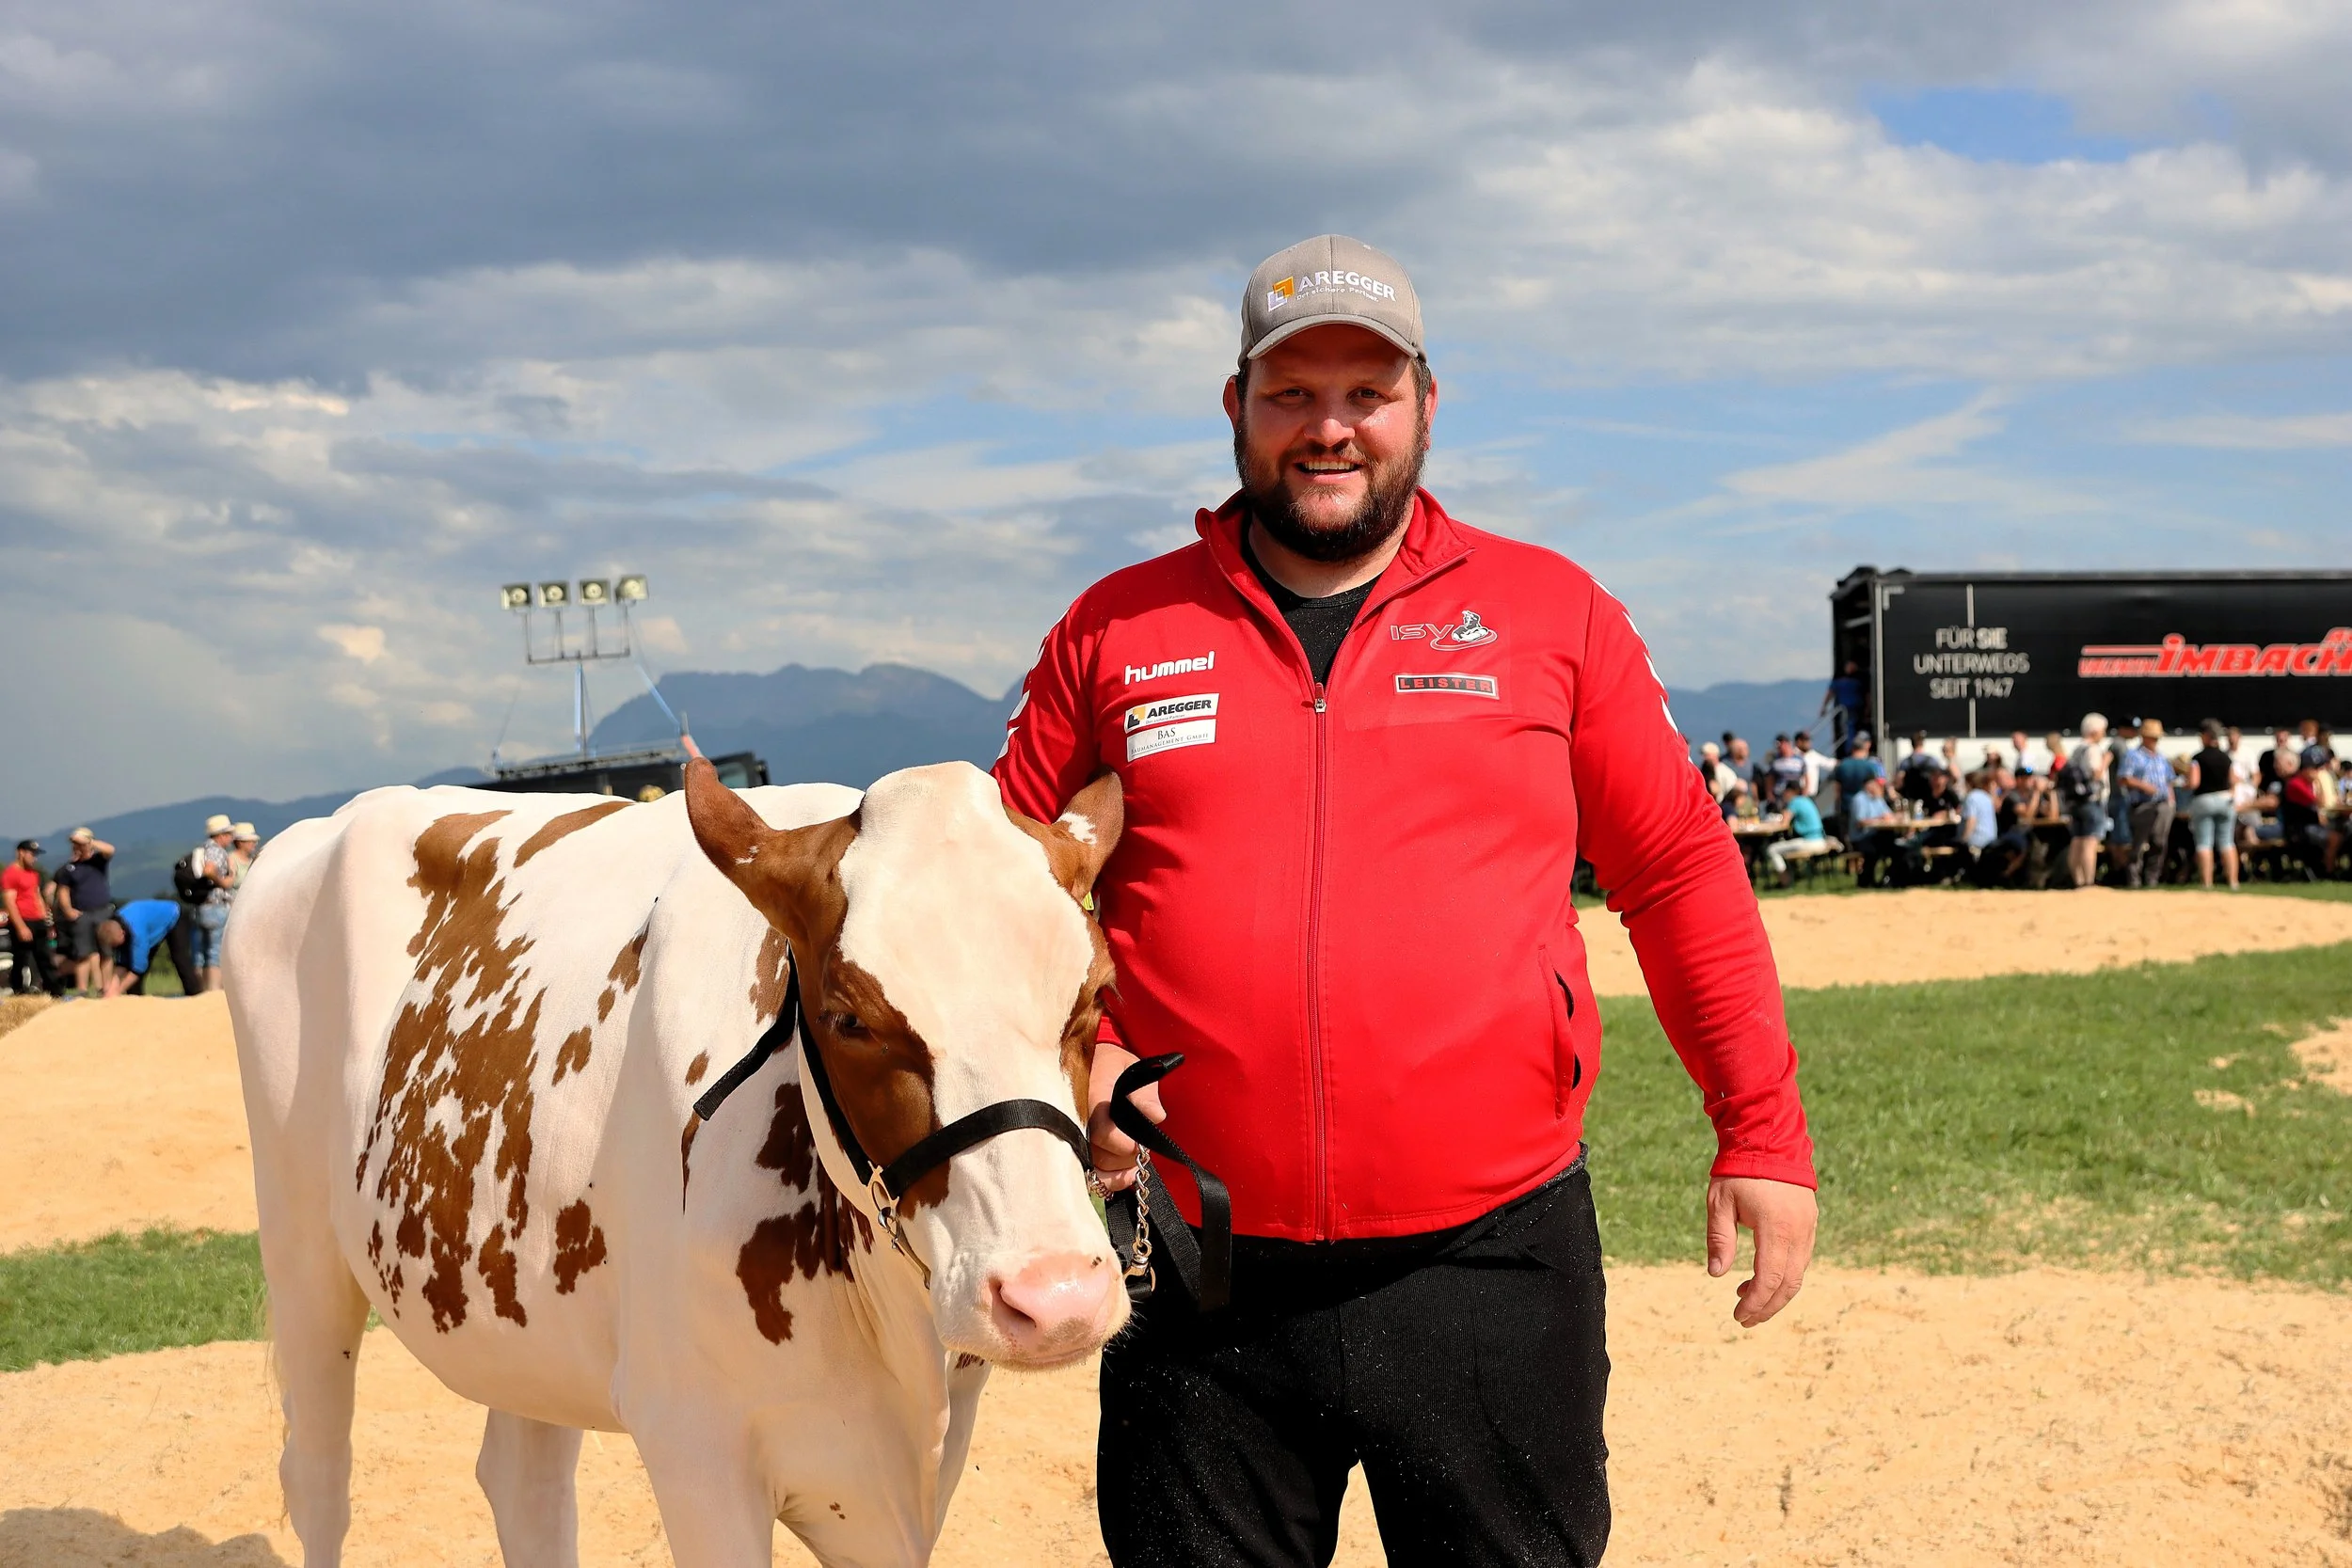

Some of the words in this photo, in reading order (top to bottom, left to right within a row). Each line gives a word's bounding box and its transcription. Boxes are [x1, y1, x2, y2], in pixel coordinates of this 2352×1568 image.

[1298, 270, 1396, 302] AREGGER
[1935, 626, 1975, 649] FÜR
[1977, 627, 2008, 649] SIE
[1124, 650, 1215, 685] hummel
[1914, 652, 2030, 674] UNTERWEGS
[1400, 678, 1491, 691] LEISTER
[1930, 677, 1970, 699] SEIT
[1147, 700, 1212, 719] AREGGER
